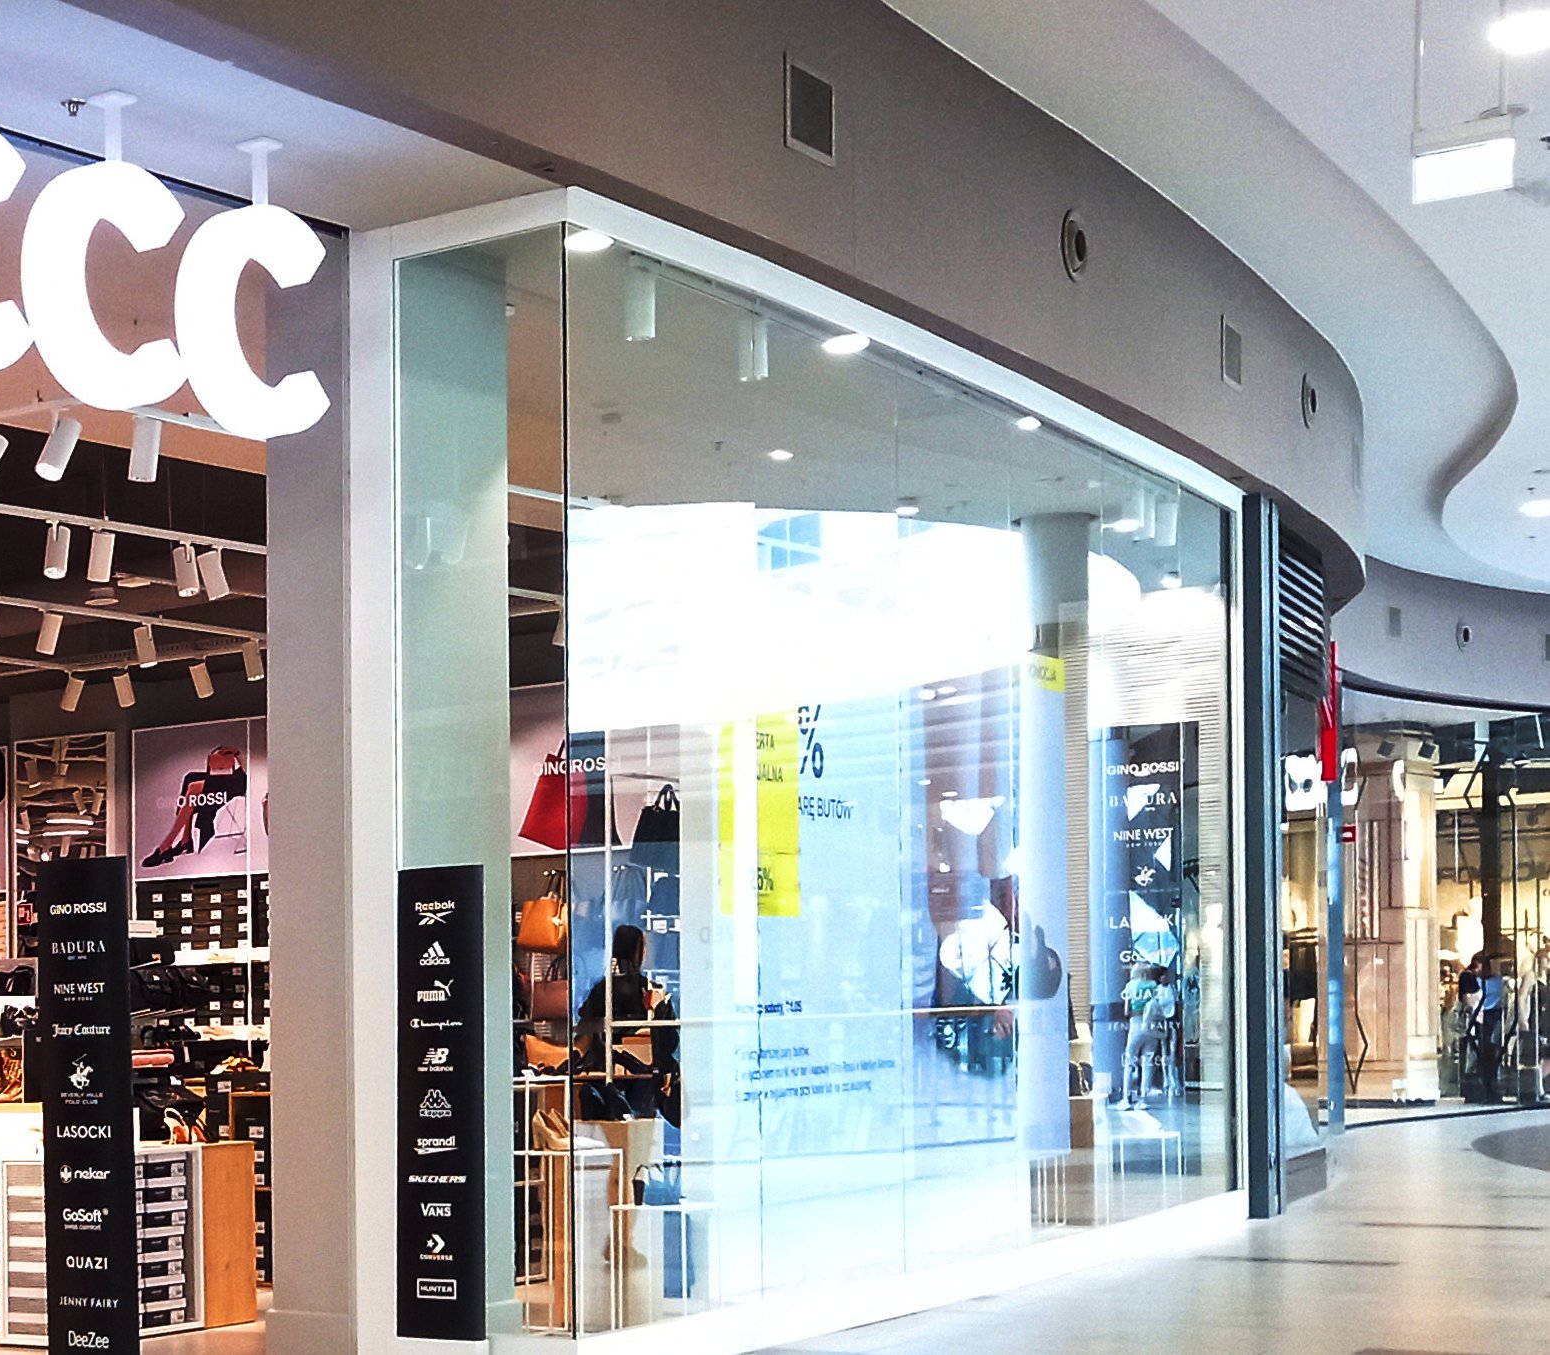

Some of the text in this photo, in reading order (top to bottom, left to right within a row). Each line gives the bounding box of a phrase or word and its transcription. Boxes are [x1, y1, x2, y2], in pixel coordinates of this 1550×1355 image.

[1142, 761, 1179, 775] ROSSI
[189, 791, 227, 807] ROSSI
[1113, 829, 1141, 841] NINE
[50, 902, 107, 915] GINO ROSSI
[415, 900, 455, 911] Reebok
[52, 940, 106, 954] BADURA
[419, 957, 450, 966] adidas
[53, 982, 105, 995] NINE WEST
[417, 990, 446, 1002] PUMA
[52, 1023, 111, 1038] Juicy Couture
[56, 1125, 112, 1138] LASOCKI
[417, 1135, 456, 1148] sprandi
[74, 1167, 110, 1180] neker
[408, 1175, 467, 1184] SKECHERS
[420, 1202, 452, 1217] VANS
[65, 1256, 109, 1270] QUAZI
[59, 1296, 119, 1308] JENNY FAIRY
[68, 1330, 110, 1349] DeeZee
